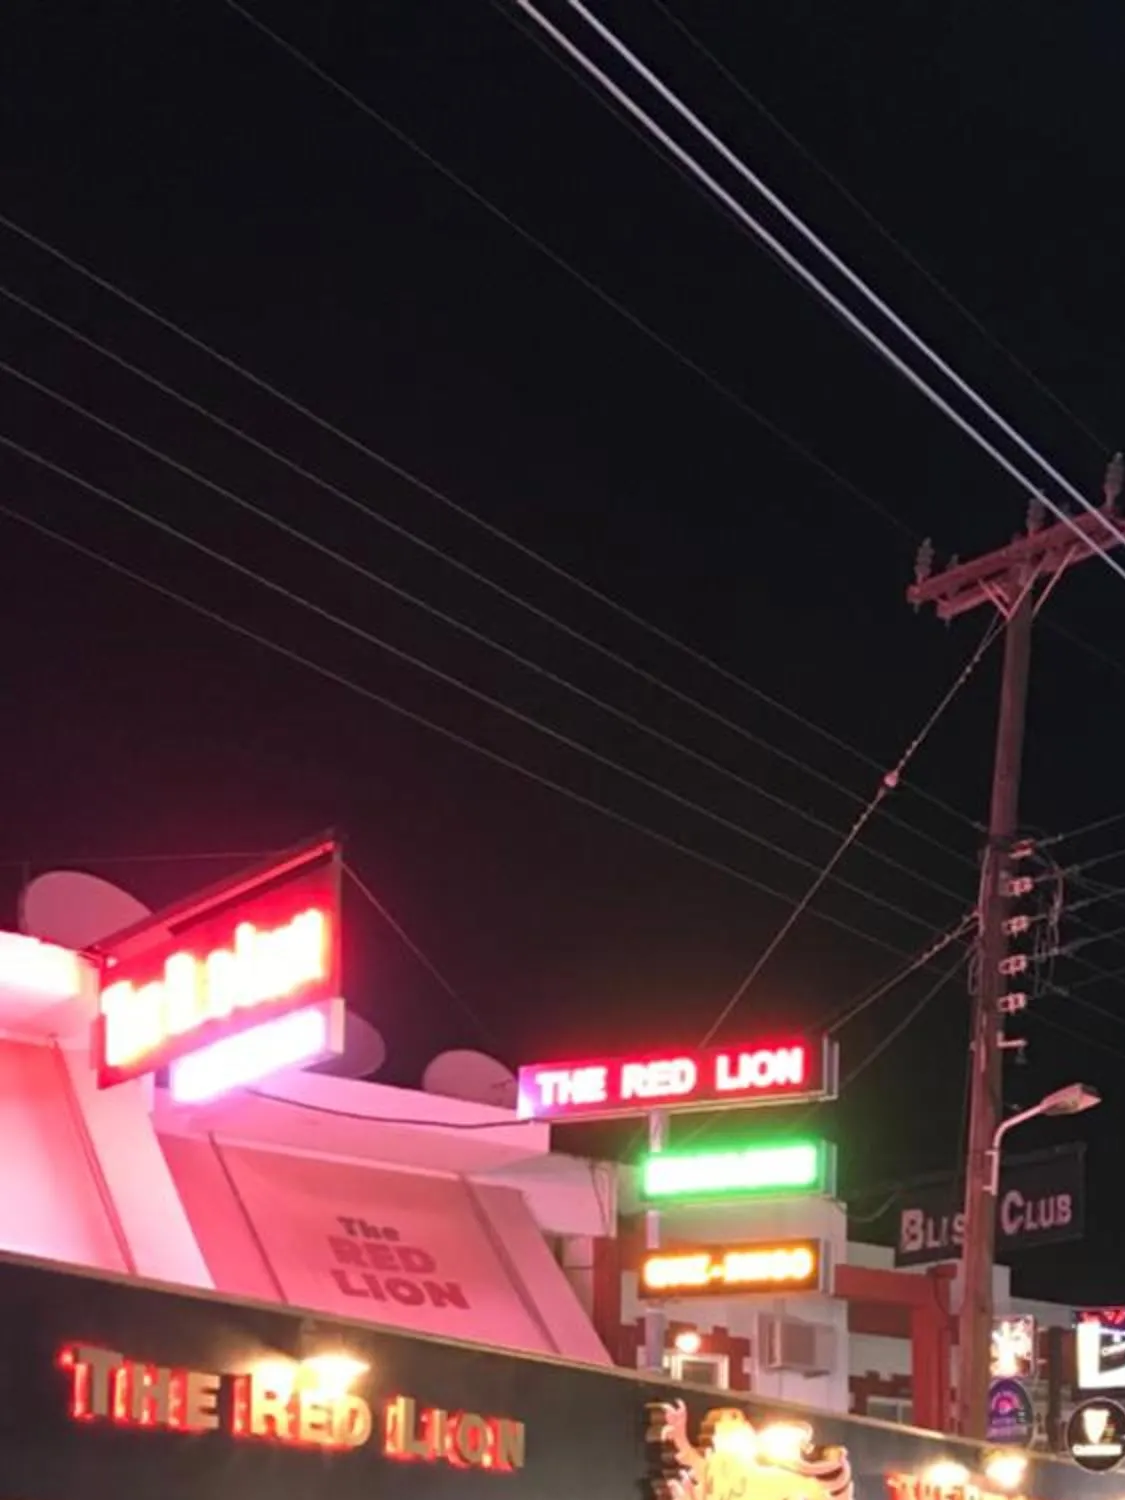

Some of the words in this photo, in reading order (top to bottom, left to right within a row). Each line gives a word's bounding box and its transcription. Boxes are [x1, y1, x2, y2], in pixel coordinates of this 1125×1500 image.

[536, 1067, 606, 1106] THE
[621, 1059, 697, 1098] RED
[716, 1047, 804, 1090] LION
[336, 1216, 400, 1243] The
[901, 1207, 967, 1252] BLIS
[1000, 1190, 1073, 1235] CLUB
[327, 1236, 437, 1275] RED
[332, 1269, 470, 1310] LION
[60, 1344, 221, 1431] THE
[231, 1364, 374, 1449] RED
[383, 1392, 527, 1470] LION
